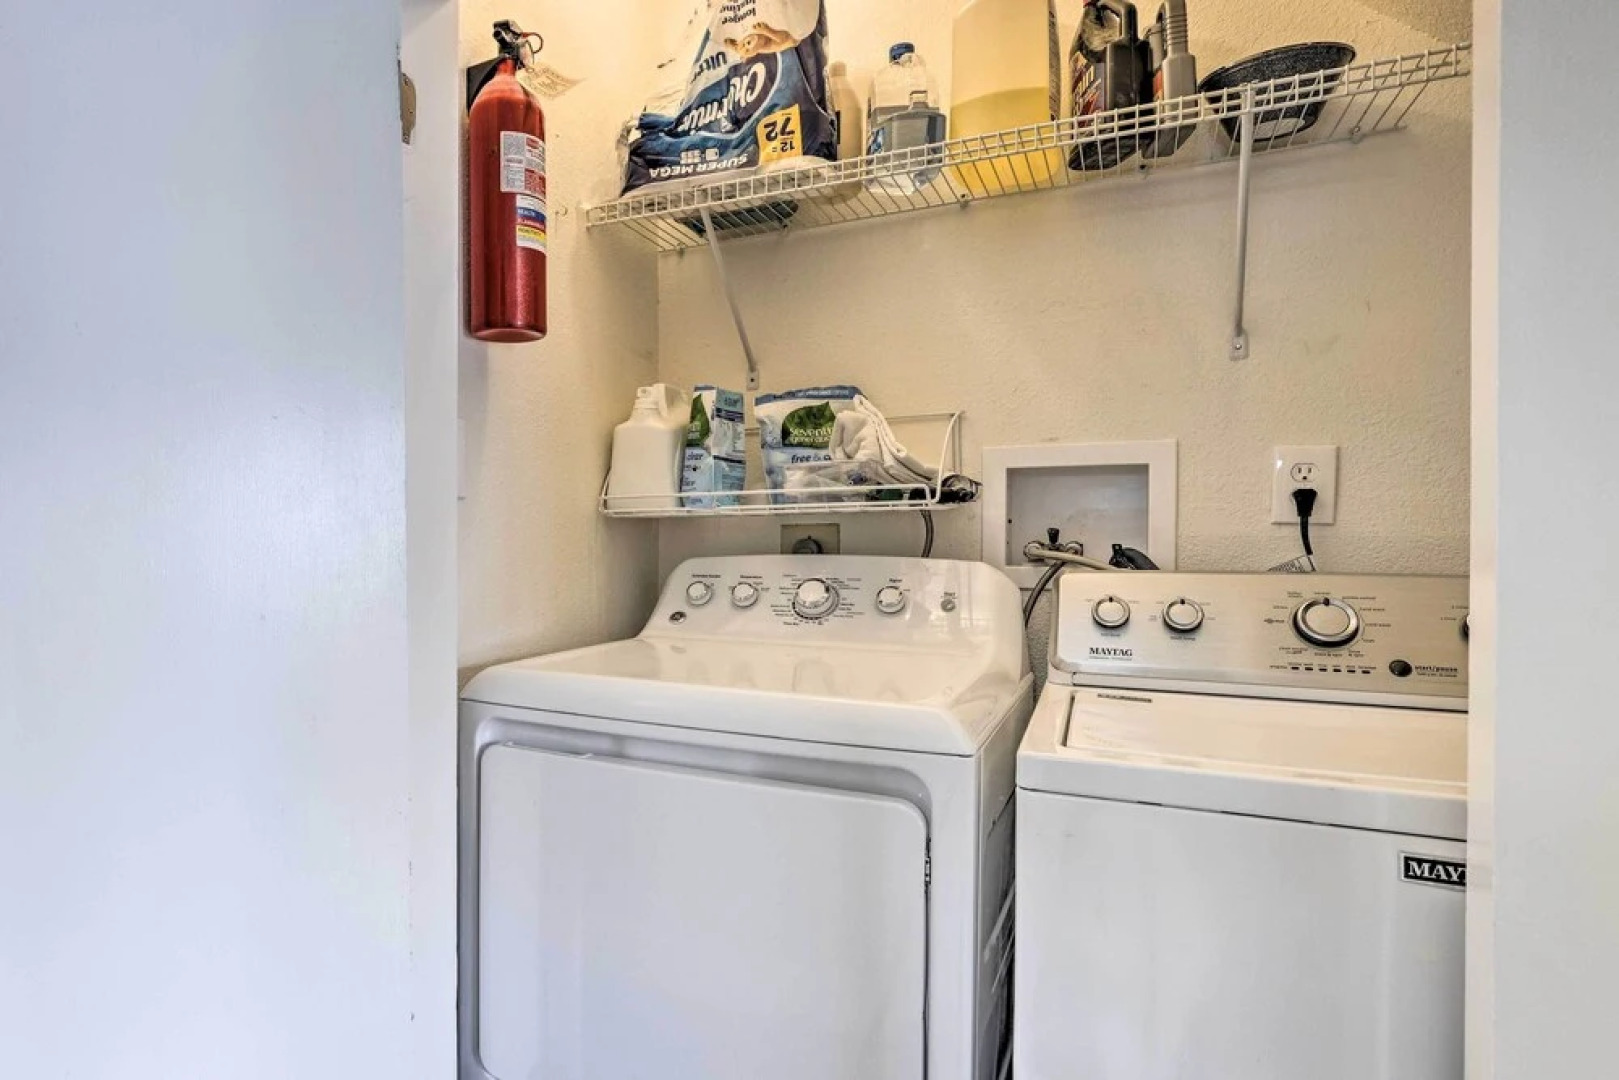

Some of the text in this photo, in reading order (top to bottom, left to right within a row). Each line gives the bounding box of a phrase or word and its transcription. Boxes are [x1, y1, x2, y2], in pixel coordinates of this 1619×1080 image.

[763, 116, 796, 142] 72
[780, 141, 796, 153] 12
[649, 153, 749, 179] SUPER MEGA
[791, 454, 811, 464] free
[1089, 647, 1133, 657] MAYTAG
